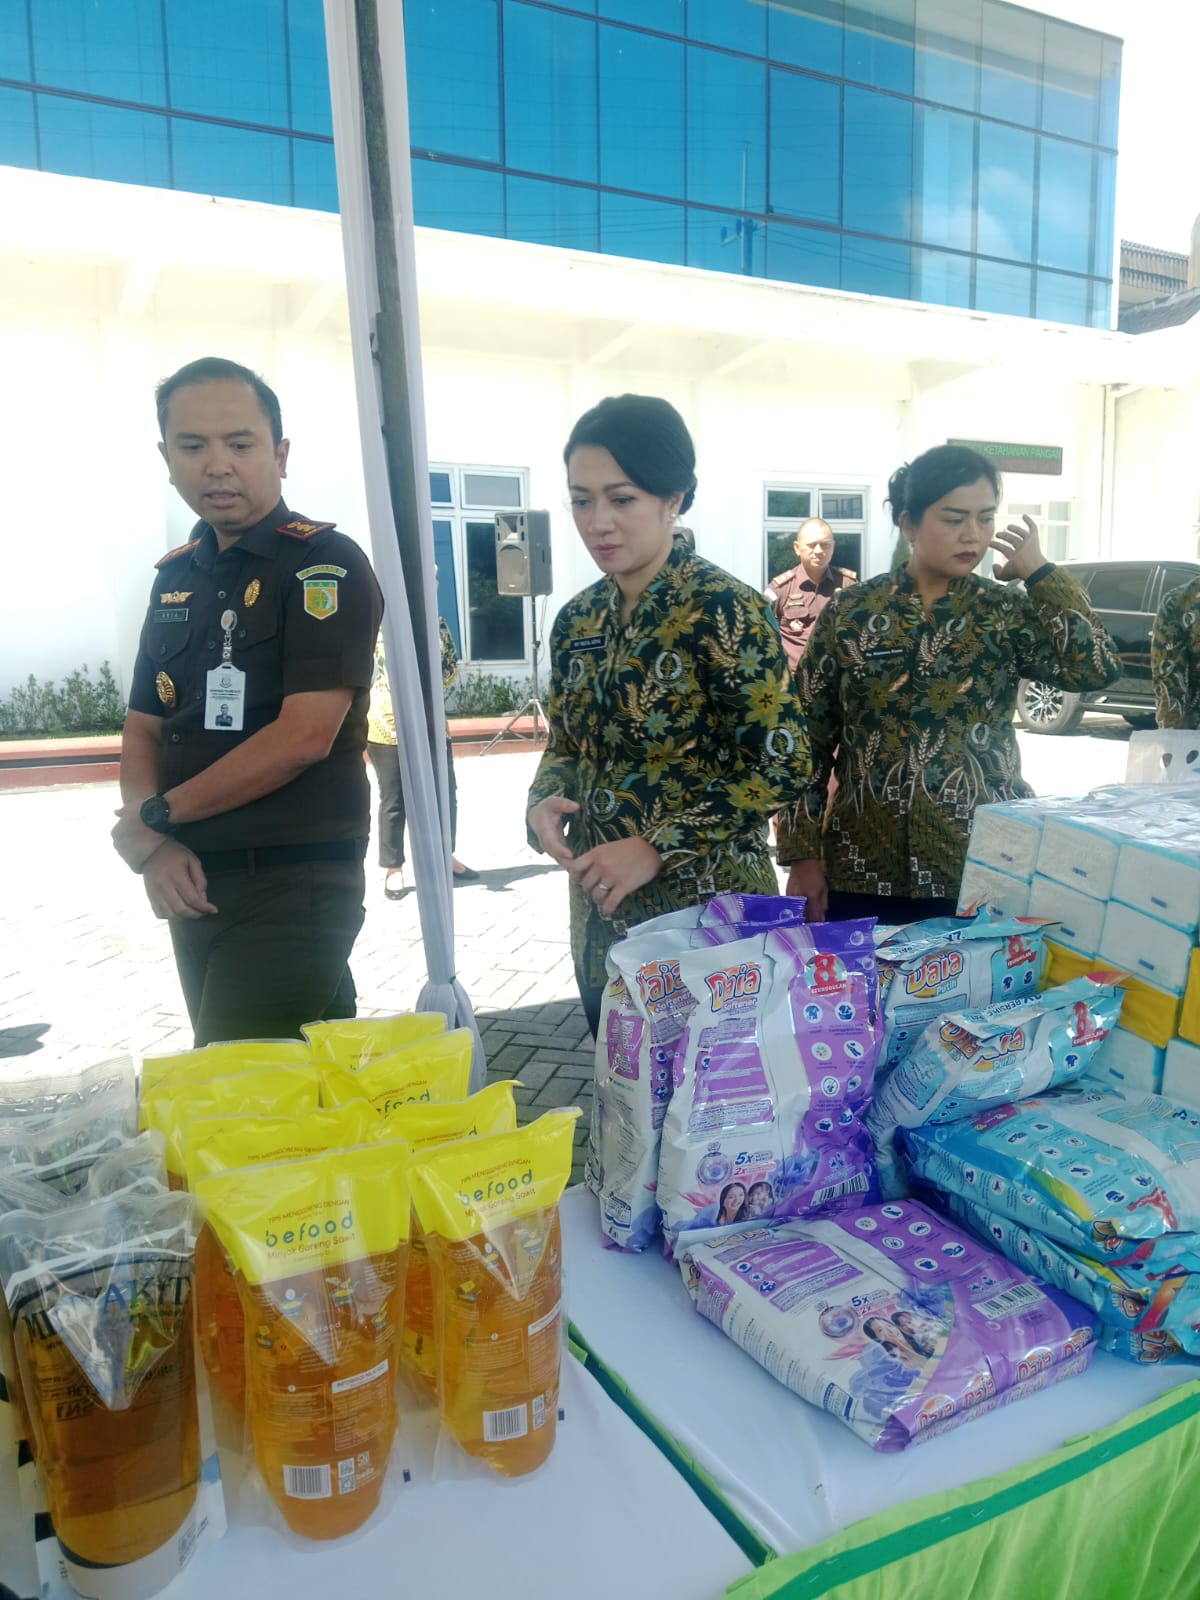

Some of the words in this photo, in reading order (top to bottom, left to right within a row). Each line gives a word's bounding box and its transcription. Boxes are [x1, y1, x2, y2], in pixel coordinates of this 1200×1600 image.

[704, 962, 761, 1013] Daia
[814, 952, 837, 987] 8
[1072, 1001, 1094, 1037] 8
[458, 1168, 533, 1207] befood
[265, 1210, 353, 1248] befood
